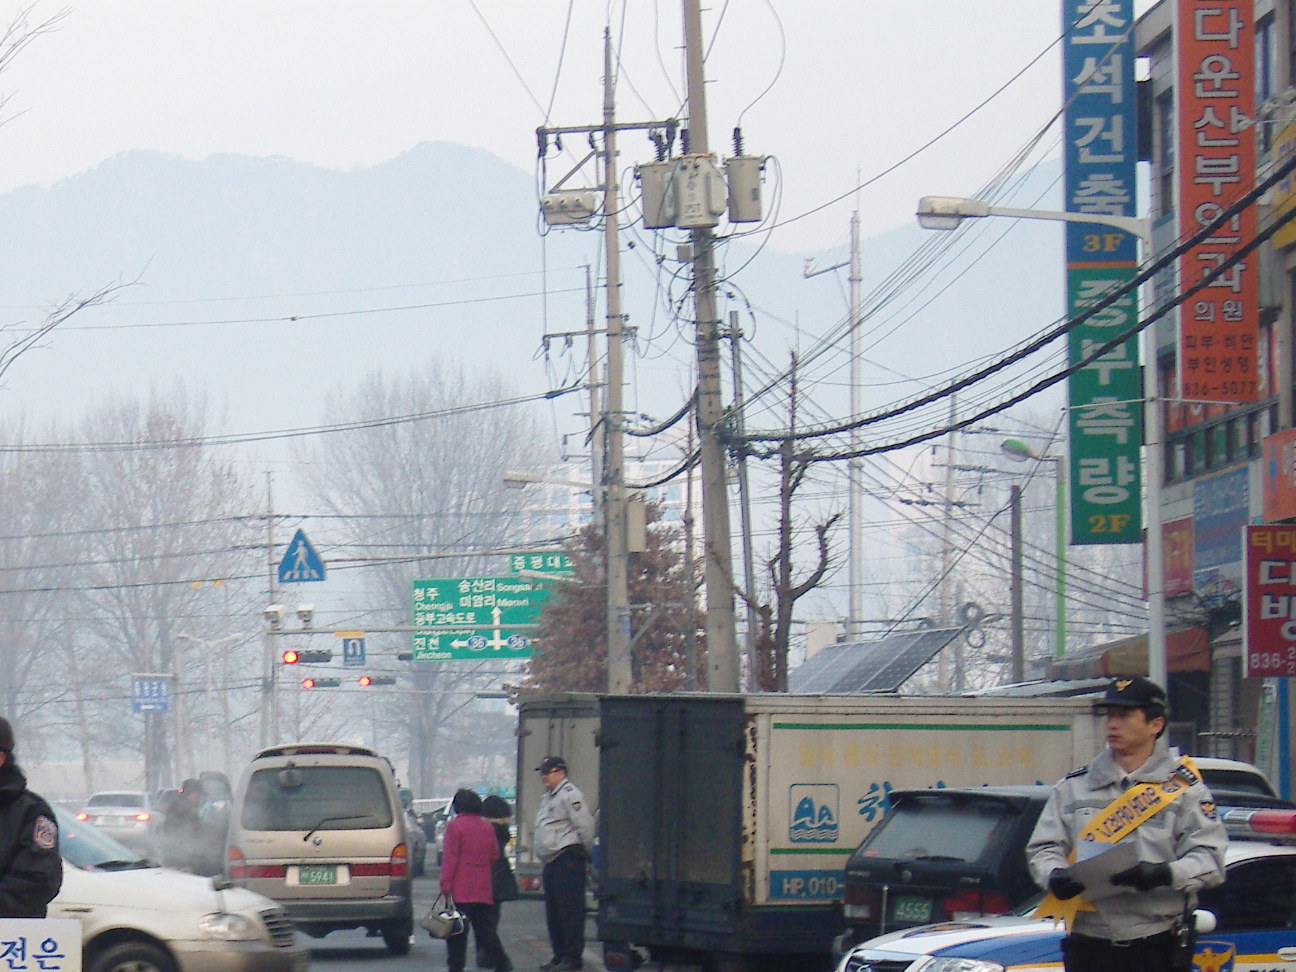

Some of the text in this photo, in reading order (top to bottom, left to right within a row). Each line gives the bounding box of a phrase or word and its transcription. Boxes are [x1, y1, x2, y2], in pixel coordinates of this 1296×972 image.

[1083, 233, 1125, 253] 3F
[1193, 300, 1244, 323] 의원
[1088, 514, 1131, 533] 2F
[413, 587, 440, 601] 청주
[458, 579, 496, 594] 송산리
[414, 637, 440, 650] 진천
